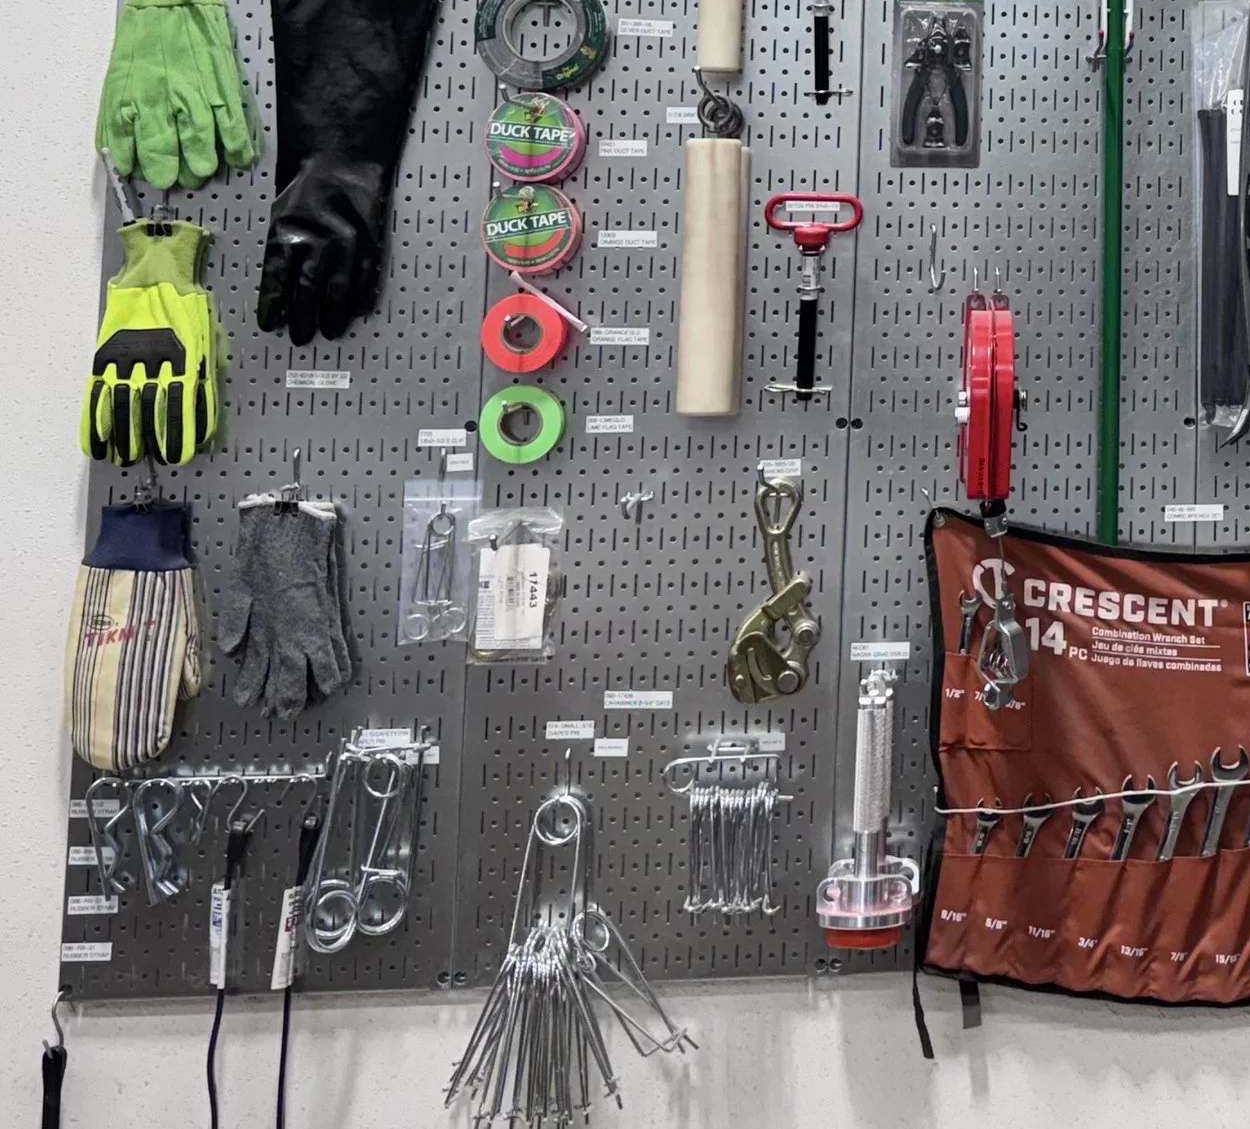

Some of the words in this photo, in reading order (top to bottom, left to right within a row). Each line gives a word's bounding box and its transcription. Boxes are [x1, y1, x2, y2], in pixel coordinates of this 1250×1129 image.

[556, 64, 579, 81] Original
[490, 122, 530, 138] DUCK
[534, 127, 571, 143] TAPE
[486, 216, 528, 237] DUCK
[529, 211, 567, 231] TAPE
[529, 572, 538, 608] 17443
[1023, 578, 1219, 627] CRESCENT
[1025, 617, 1068, 655] 14
[1069, 646, 1088, 660] PC
[1092, 626, 1151, 641] Combination
[1153, 633, 1188, 644] Wrench
[1189, 635, 1205, 645] Set
[1092, 641, 1109, 651] Jeu
[1111, 643, 1123, 652] de
[1125, 644, 1145, 654] clés
[1146, 647, 1178, 657] mixtes
[1091, 654, 1120, 666] Juego
[1122, 657, 1135, 667] de
[1136, 658, 1164, 669] llaves
[1165, 661, 1222, 672] combinadas
[945, 688, 965, 698] 1/2"
[1028, 925, 1055, 939] 11/16"
[1078, 937, 1098, 948] 3/4"
